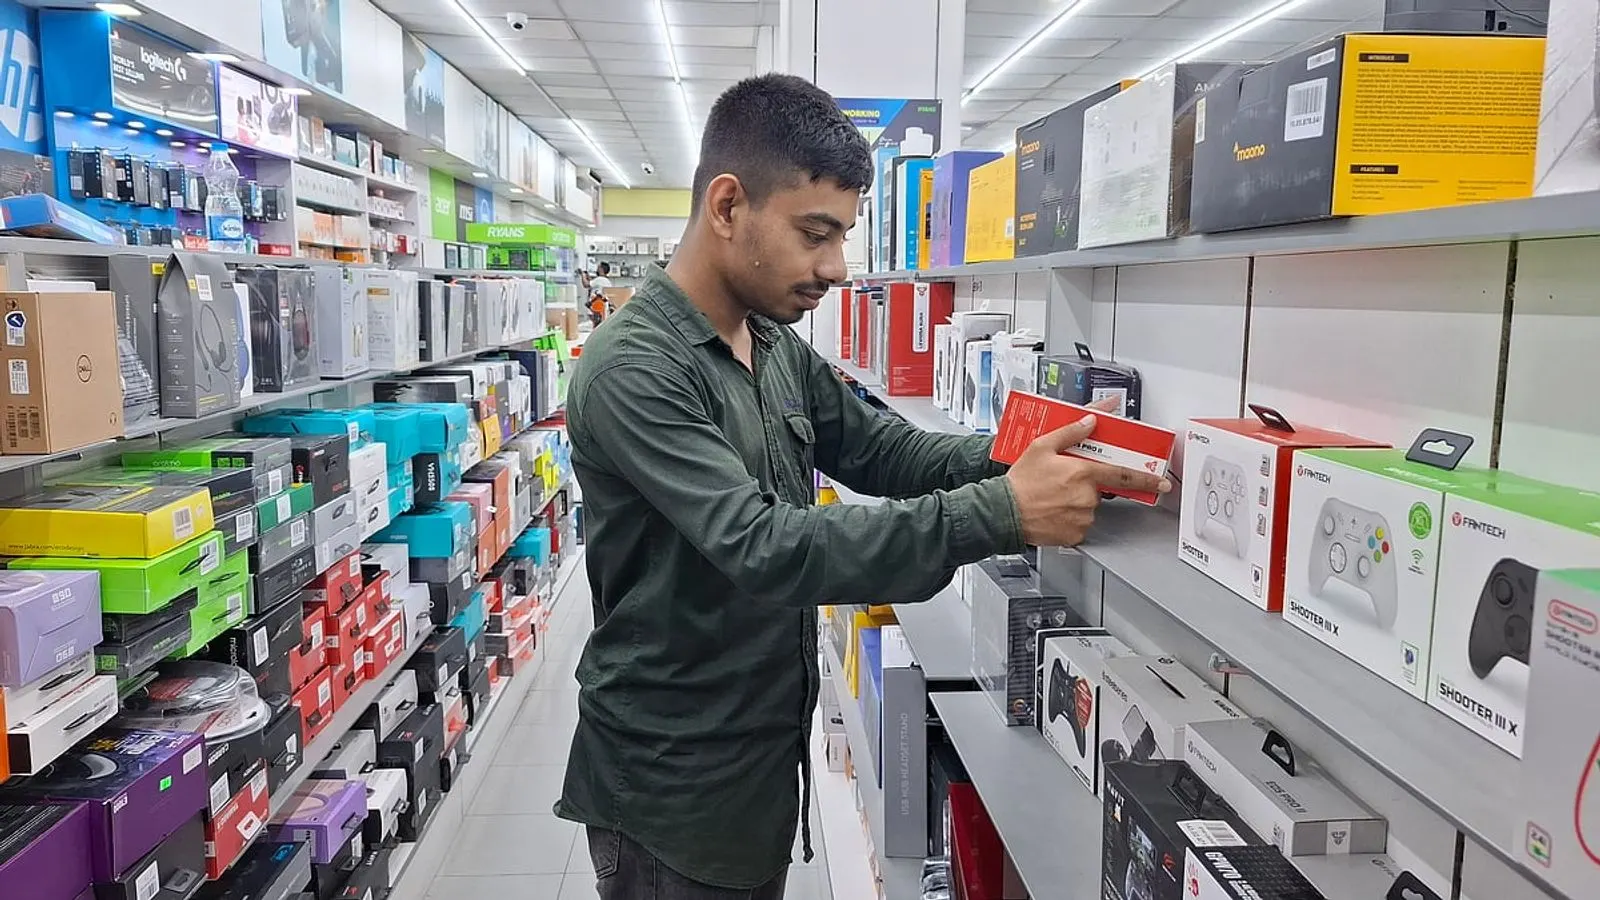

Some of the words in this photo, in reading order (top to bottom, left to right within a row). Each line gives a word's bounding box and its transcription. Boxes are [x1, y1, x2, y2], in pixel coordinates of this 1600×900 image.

[140, 46, 175, 74] logitech
[1237, 143, 1266, 161] maono
[487, 226, 526, 239] RYANS
[1081, 443, 1097, 452] PRO
[1304, 468, 1331, 484] FANTECH
[1463, 516, 1506, 540] FANTECH
[1182, 541, 1204, 560] SHOOTER
[1290, 600, 1324, 629] SHOOTER
[1333, 623, 1339, 637] X
[1439, 682, 1493, 722] SHOOTER
[1495, 712, 1506, 730] III
[1508, 720, 1518, 737] X
[900, 712, 908, 738] STAND
[900, 740, 909, 778] HEADSET
[901, 780, 909, 798] HUB
[901, 799, 909, 815] USB
[1281, 792, 1301, 809] PRO
